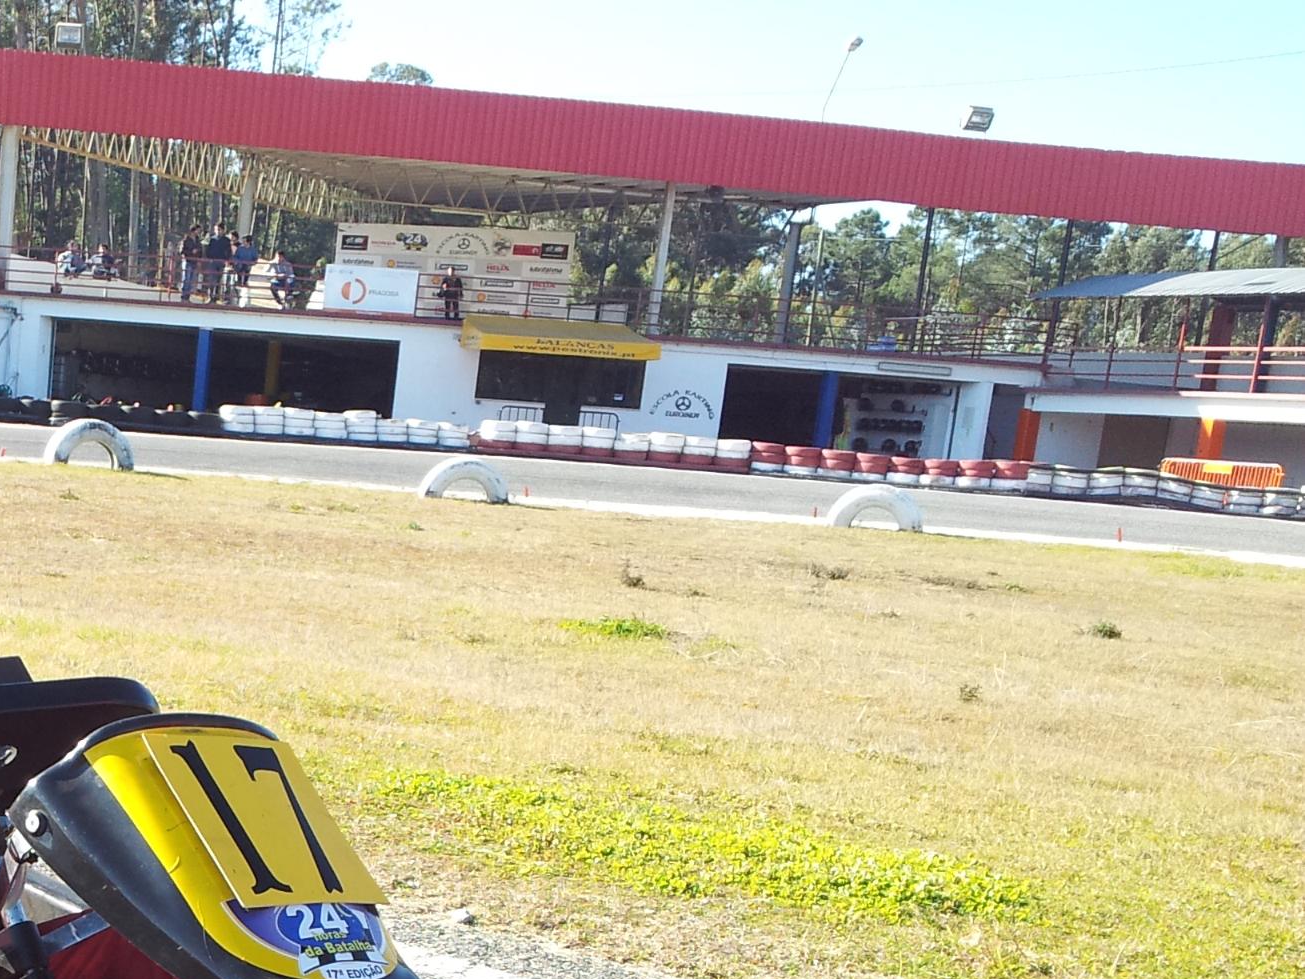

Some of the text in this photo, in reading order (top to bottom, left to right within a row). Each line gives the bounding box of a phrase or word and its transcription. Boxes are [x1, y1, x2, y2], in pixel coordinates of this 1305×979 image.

[170, 740, 344, 894] 17
[286, 903, 349, 940] 24
[304, 940, 372, 958] da Batalha
[326, 964, 384, 979] 17ª EDIÇÃO
